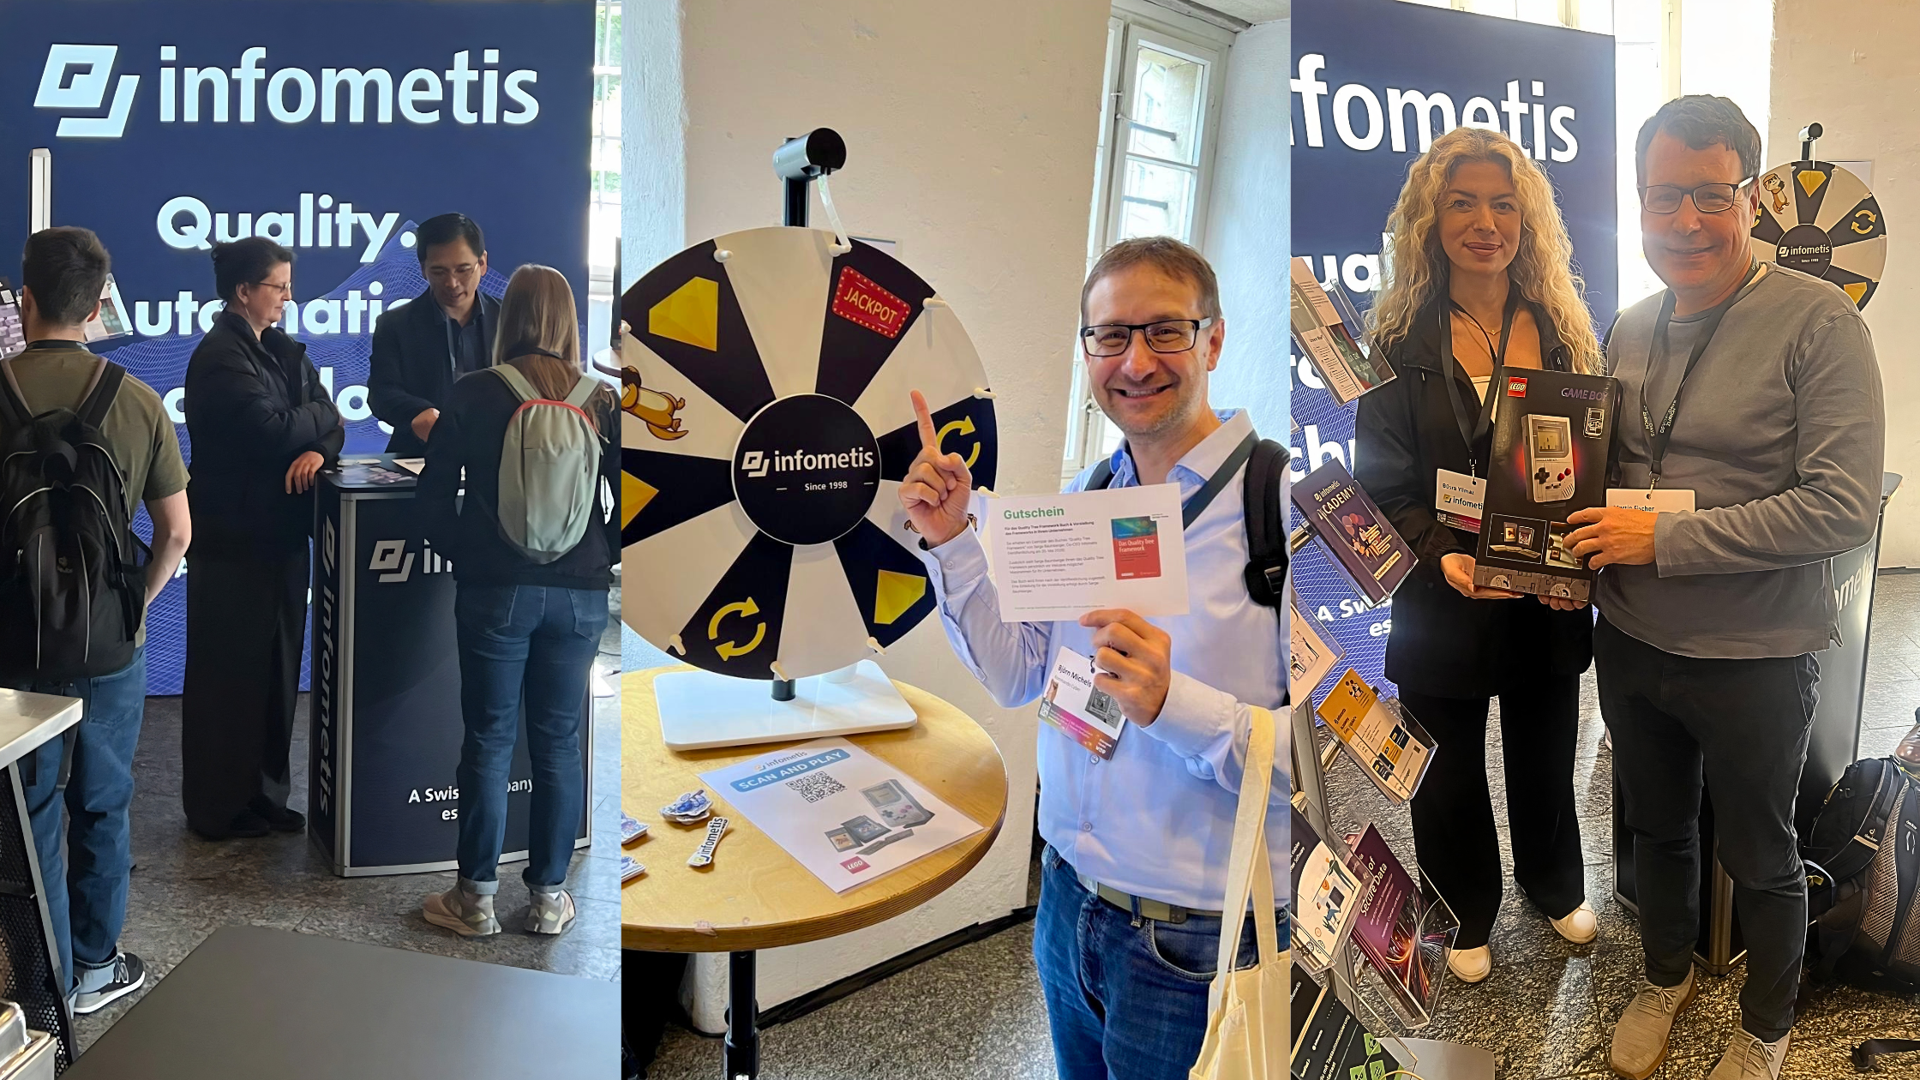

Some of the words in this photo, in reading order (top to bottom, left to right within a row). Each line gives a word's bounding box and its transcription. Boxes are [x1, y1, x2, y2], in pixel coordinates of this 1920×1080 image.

[159, 46, 540, 125] infometis
[1290, 53, 1578, 163] fometis
[157, 192, 417, 263] Quality.
[1790, 244, 1830, 256] infometis
[844, 287, 898, 325] JACKPOT
[1509, 382, 1526, 392] LEGO
[1561, 388, 1588, 400] GAME
[774, 446, 874, 472] infometis
[804, 482, 826, 492] Since
[828, 481, 848, 490] 1998
[1320, 480, 1341, 498] infometis
[1452, 496, 1483, 510] infometi
[1004, 506, 1064, 520] Gutschein
[1318, 605, 1334, 622] A
[1071, 672, 1092, 688] Michels
[320, 584, 335, 817] infometis
[766, 750, 808, 767] infometis
[739, 774, 777, 789] SCAN
[780, 763, 808, 776] AND
[810, 751, 842, 766] PLAY
[408, 789, 420, 804] A
[425, 786, 460, 802] Swis
[698, 818, 723, 855] infometis
[847, 860, 863, 870] LEGO
[1369, 856, 1376, 871] of
[1360, 884, 1378, 916] Secure
[1374, 862, 1388, 886] Data
